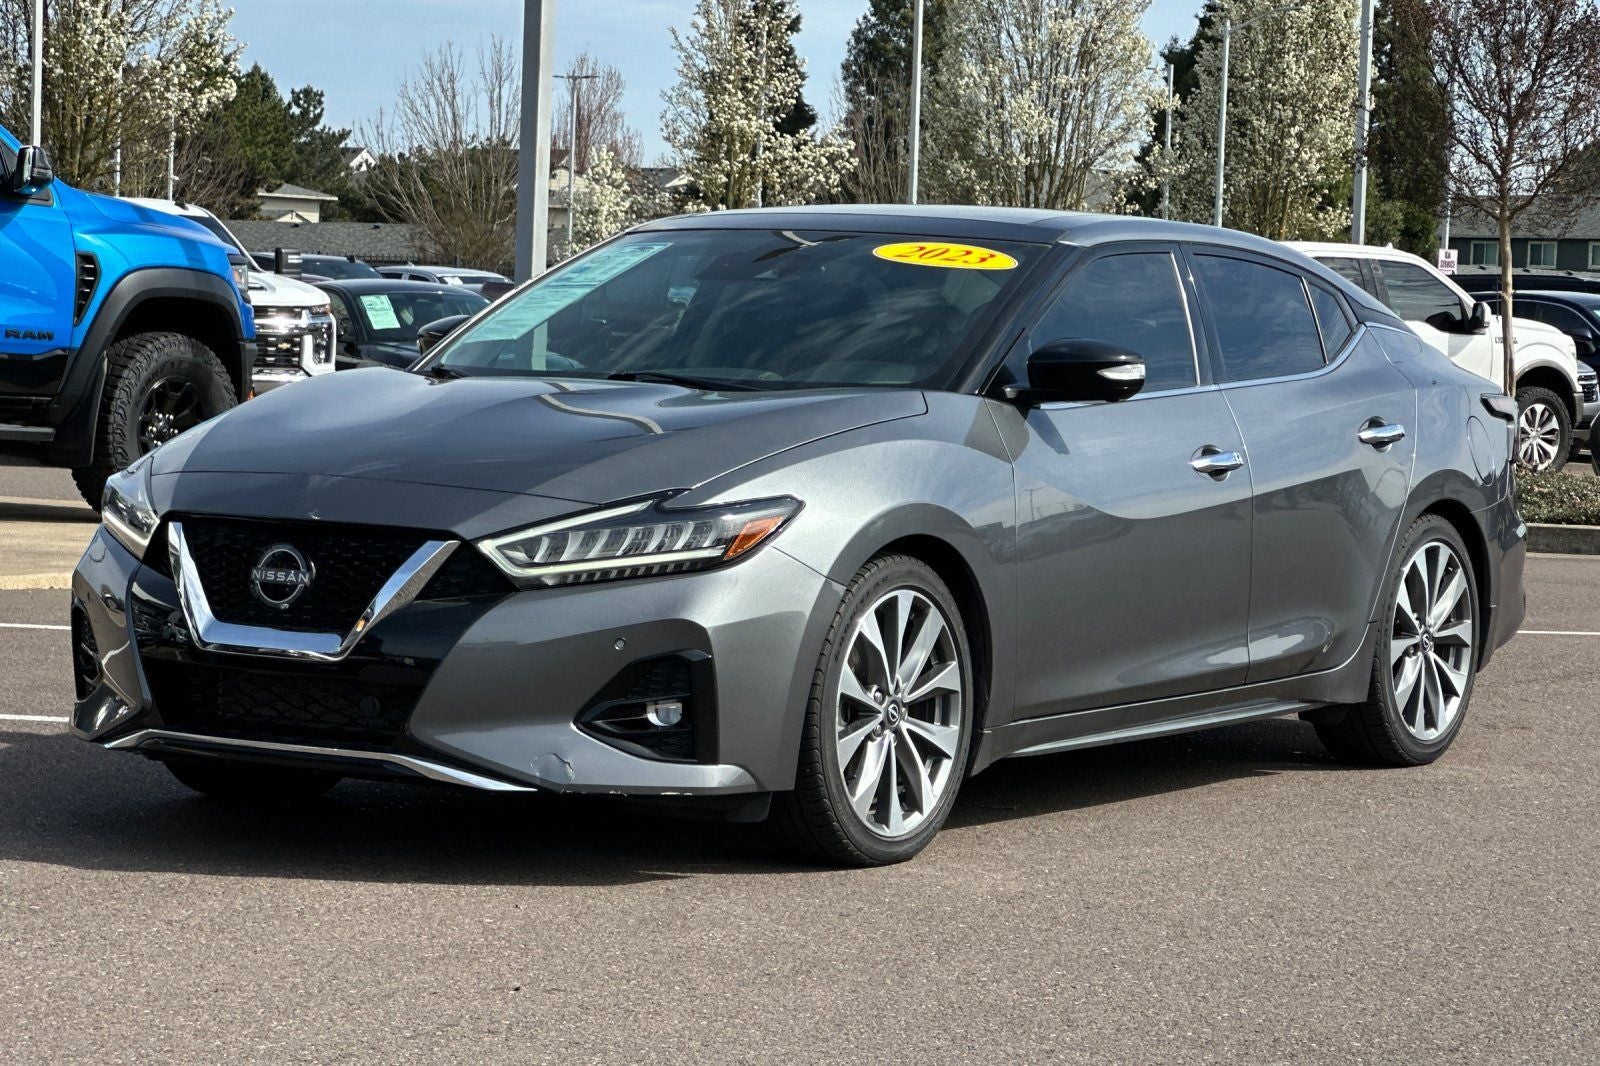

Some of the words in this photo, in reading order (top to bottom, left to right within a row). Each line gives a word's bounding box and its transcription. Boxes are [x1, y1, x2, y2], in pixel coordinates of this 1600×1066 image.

[891, 245, 997, 264] 2023
[4, 328, 54, 341] RAM
[252, 569, 309, 583] NISSAN
